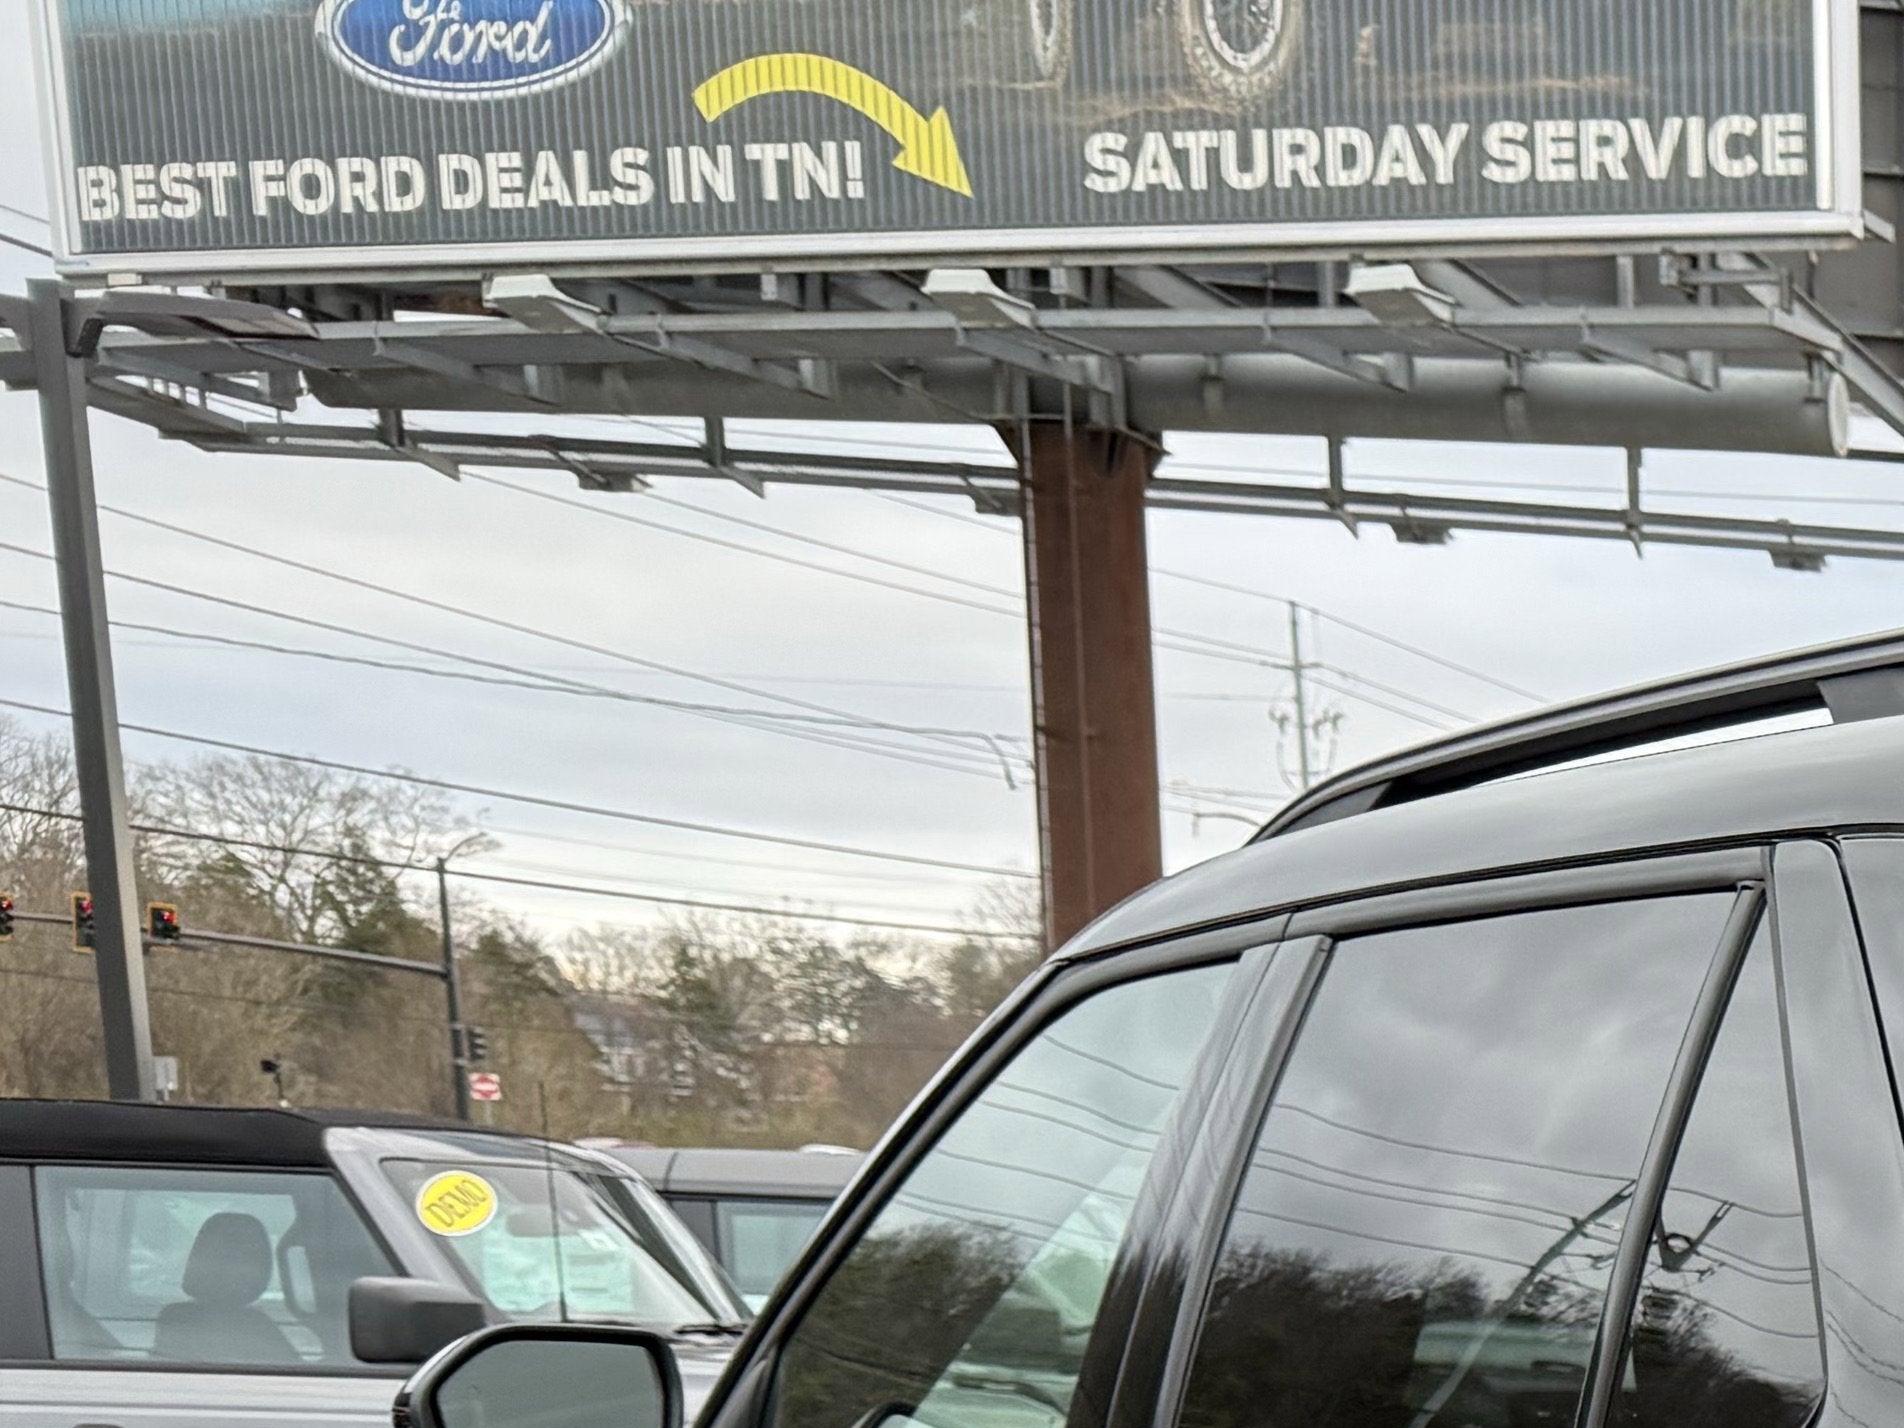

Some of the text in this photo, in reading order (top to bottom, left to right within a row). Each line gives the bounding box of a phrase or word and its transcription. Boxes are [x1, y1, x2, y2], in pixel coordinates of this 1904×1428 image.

[77, 140, 864, 222] BEST FORD DEALS IN TN!
[1083, 112, 1808, 194] SATURDAY SERVICE
[426, 1178, 487, 1228] DEMO
